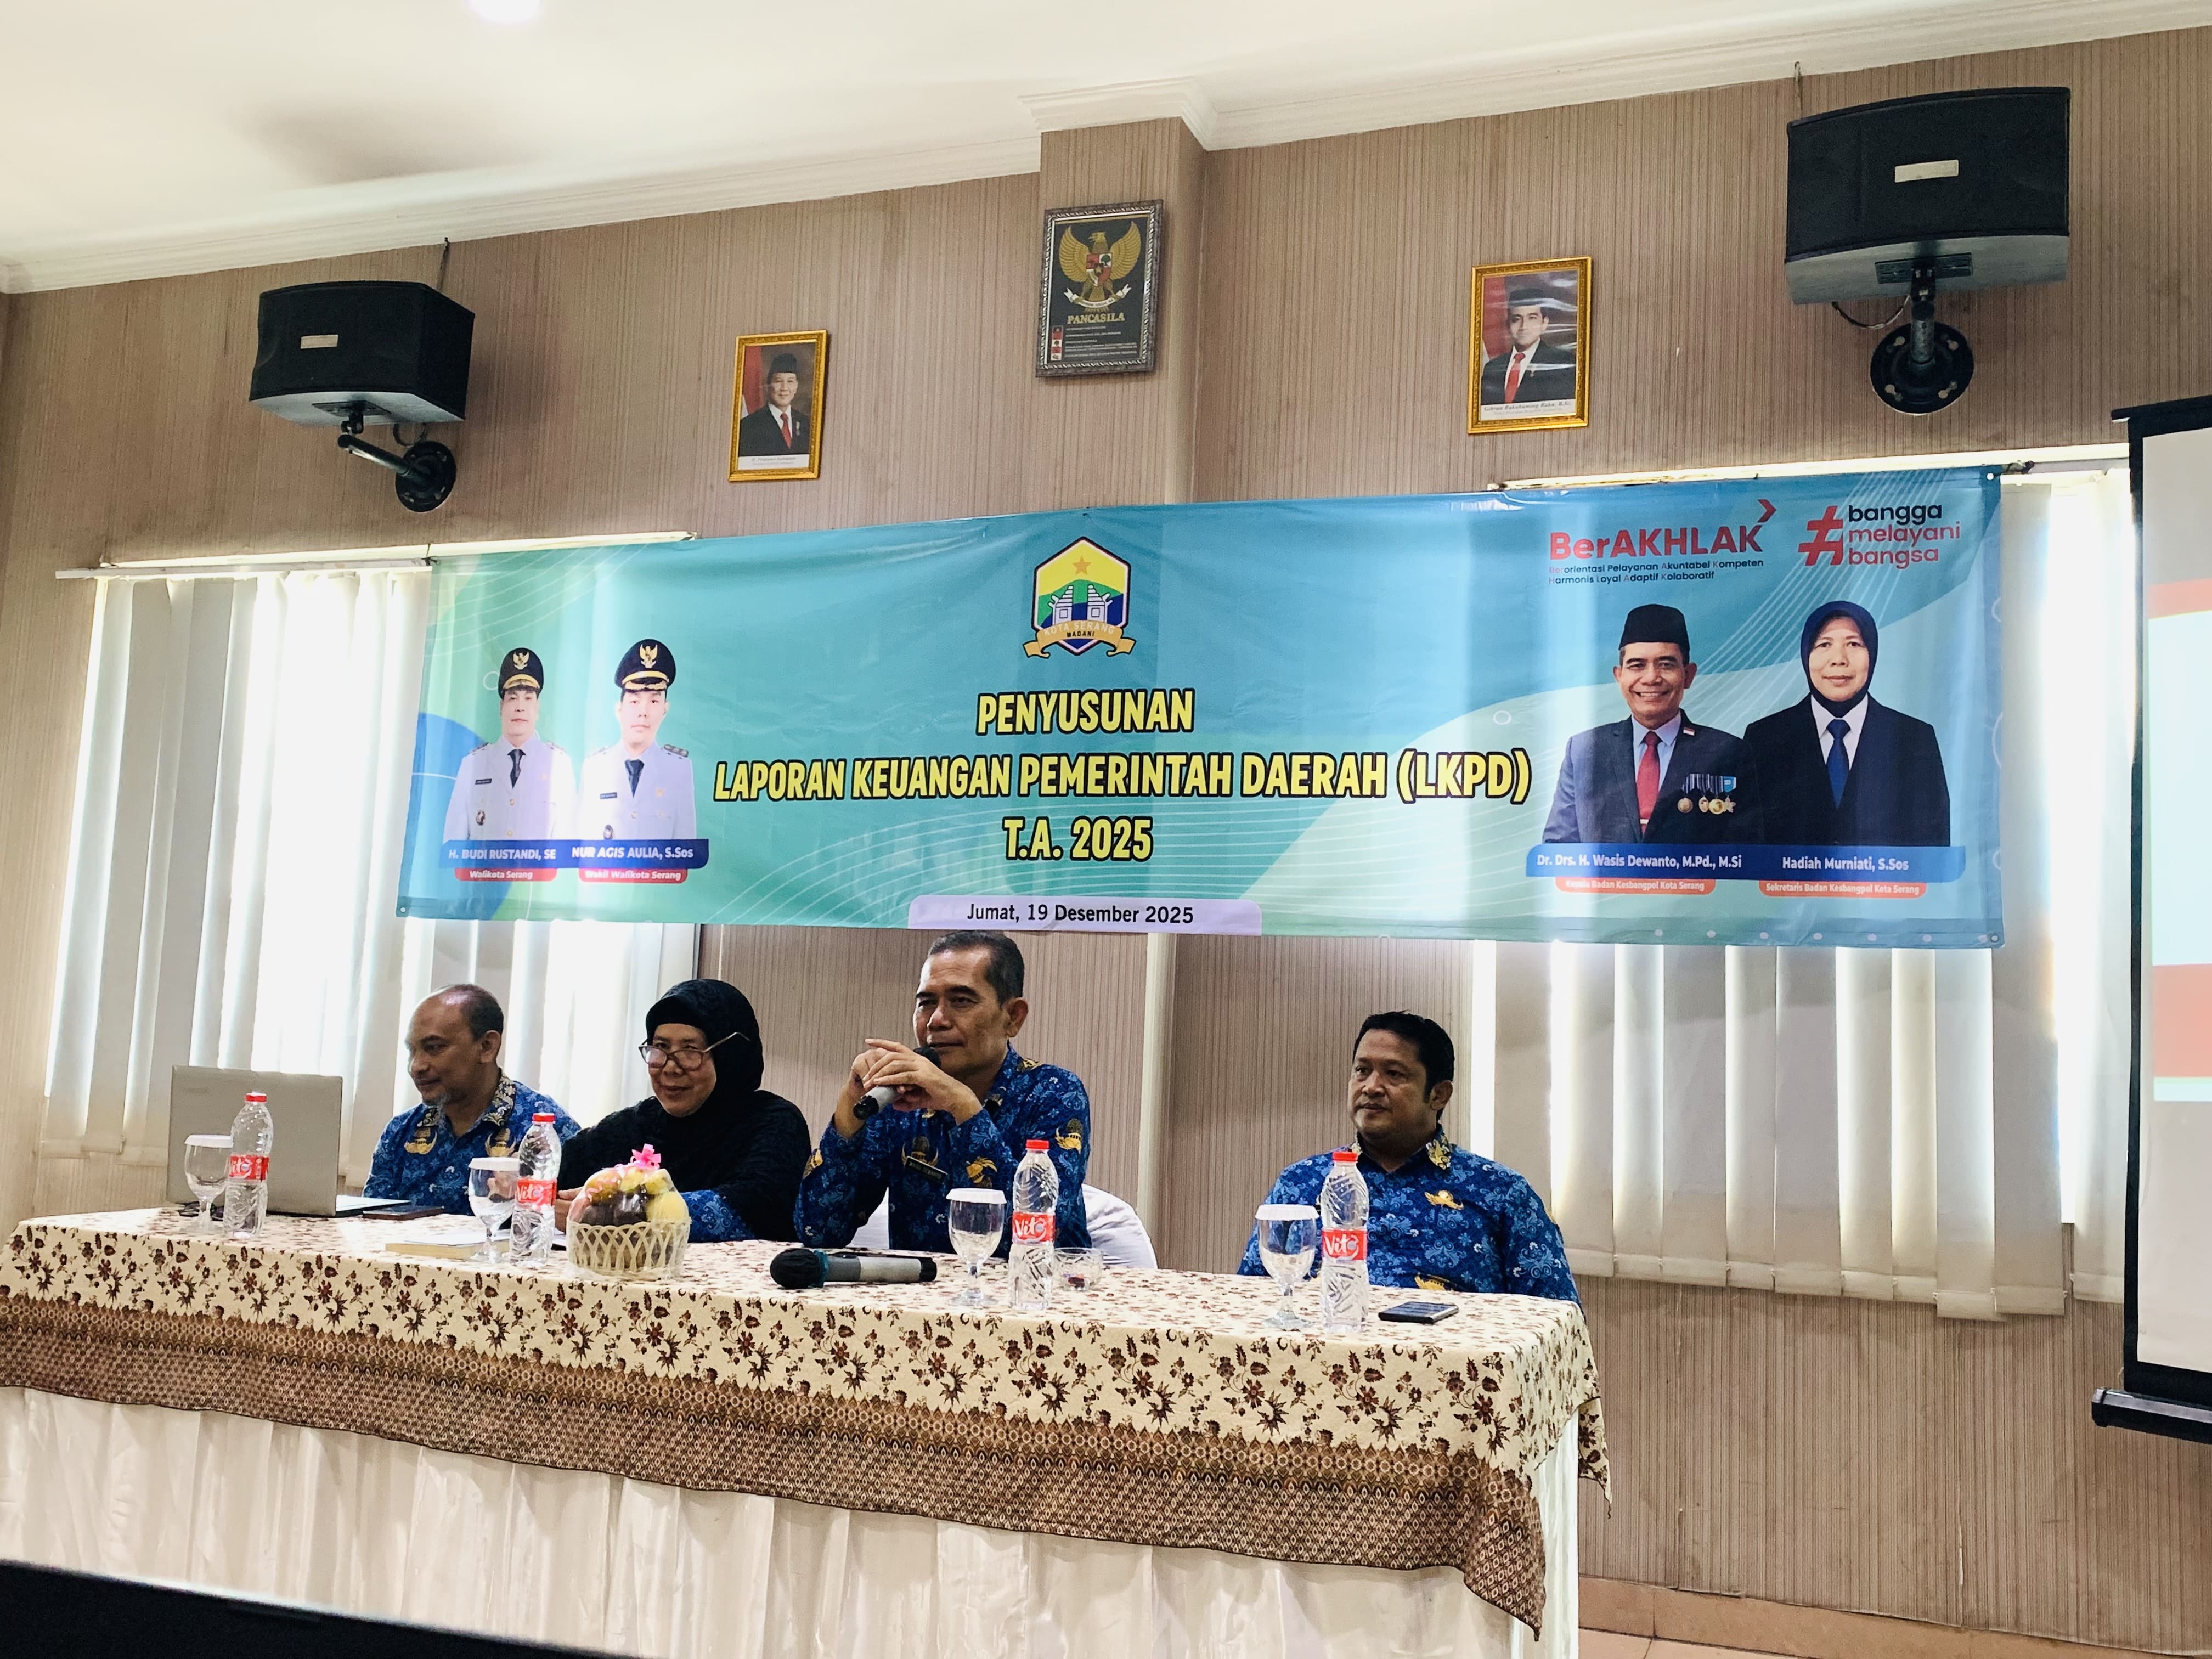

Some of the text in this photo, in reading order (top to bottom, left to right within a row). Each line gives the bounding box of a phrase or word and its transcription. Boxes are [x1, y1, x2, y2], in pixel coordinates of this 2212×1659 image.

[1067, 312, 1125, 324] PANCASILA
[1848, 504, 1942, 525] bangga
[1848, 521, 1960, 547] melayani
[1550, 525, 1763, 560] BerAKHLAK
[1549, 558, 1764, 574] Berorientasi Pelayanan Akuntabel Kompeten
[1848, 548, 1939, 569] bangsa
[1549, 571, 1714, 584] Harmonis Loyal Adaptif Kolaboratif
[1043, 622, 1114, 636] KOTA SERANG
[977, 689, 1195, 735] PENYUSUNAN
[714, 748, 1532, 804] LAPORAN KEUANGAN PEMERINTAH DAERAH (LKPD)
[1002, 816, 1153, 861] T.A. 2025
[448, 849, 556, 861] H. BUDI RUSTANDI, SE
[572, 847, 693, 860] NUR AGIS AULIA, S.Sos
[1537, 853, 1742, 870] Dr. Drs. H. Wasis Dewanto, M.Pd., M.Si
[1782, 856, 1909, 872] Hadiah Murniati, S.Sos
[469, 870, 533, 880] Walikota Serang
[584, 870, 681, 881] Wakil Walikota Serang
[1592, 880, 1615, 889] Badan
[1616, 881, 1659, 891] Kesbangpol
[1660, 881, 1678, 890] Kota
[1679, 882, 1705, 891] Serang
[1765, 883, 1920, 895] Sekretaris Badan Kesbangpol Kota Serang
[967, 904, 1194, 924] Jumat, 19 Desember 2025
